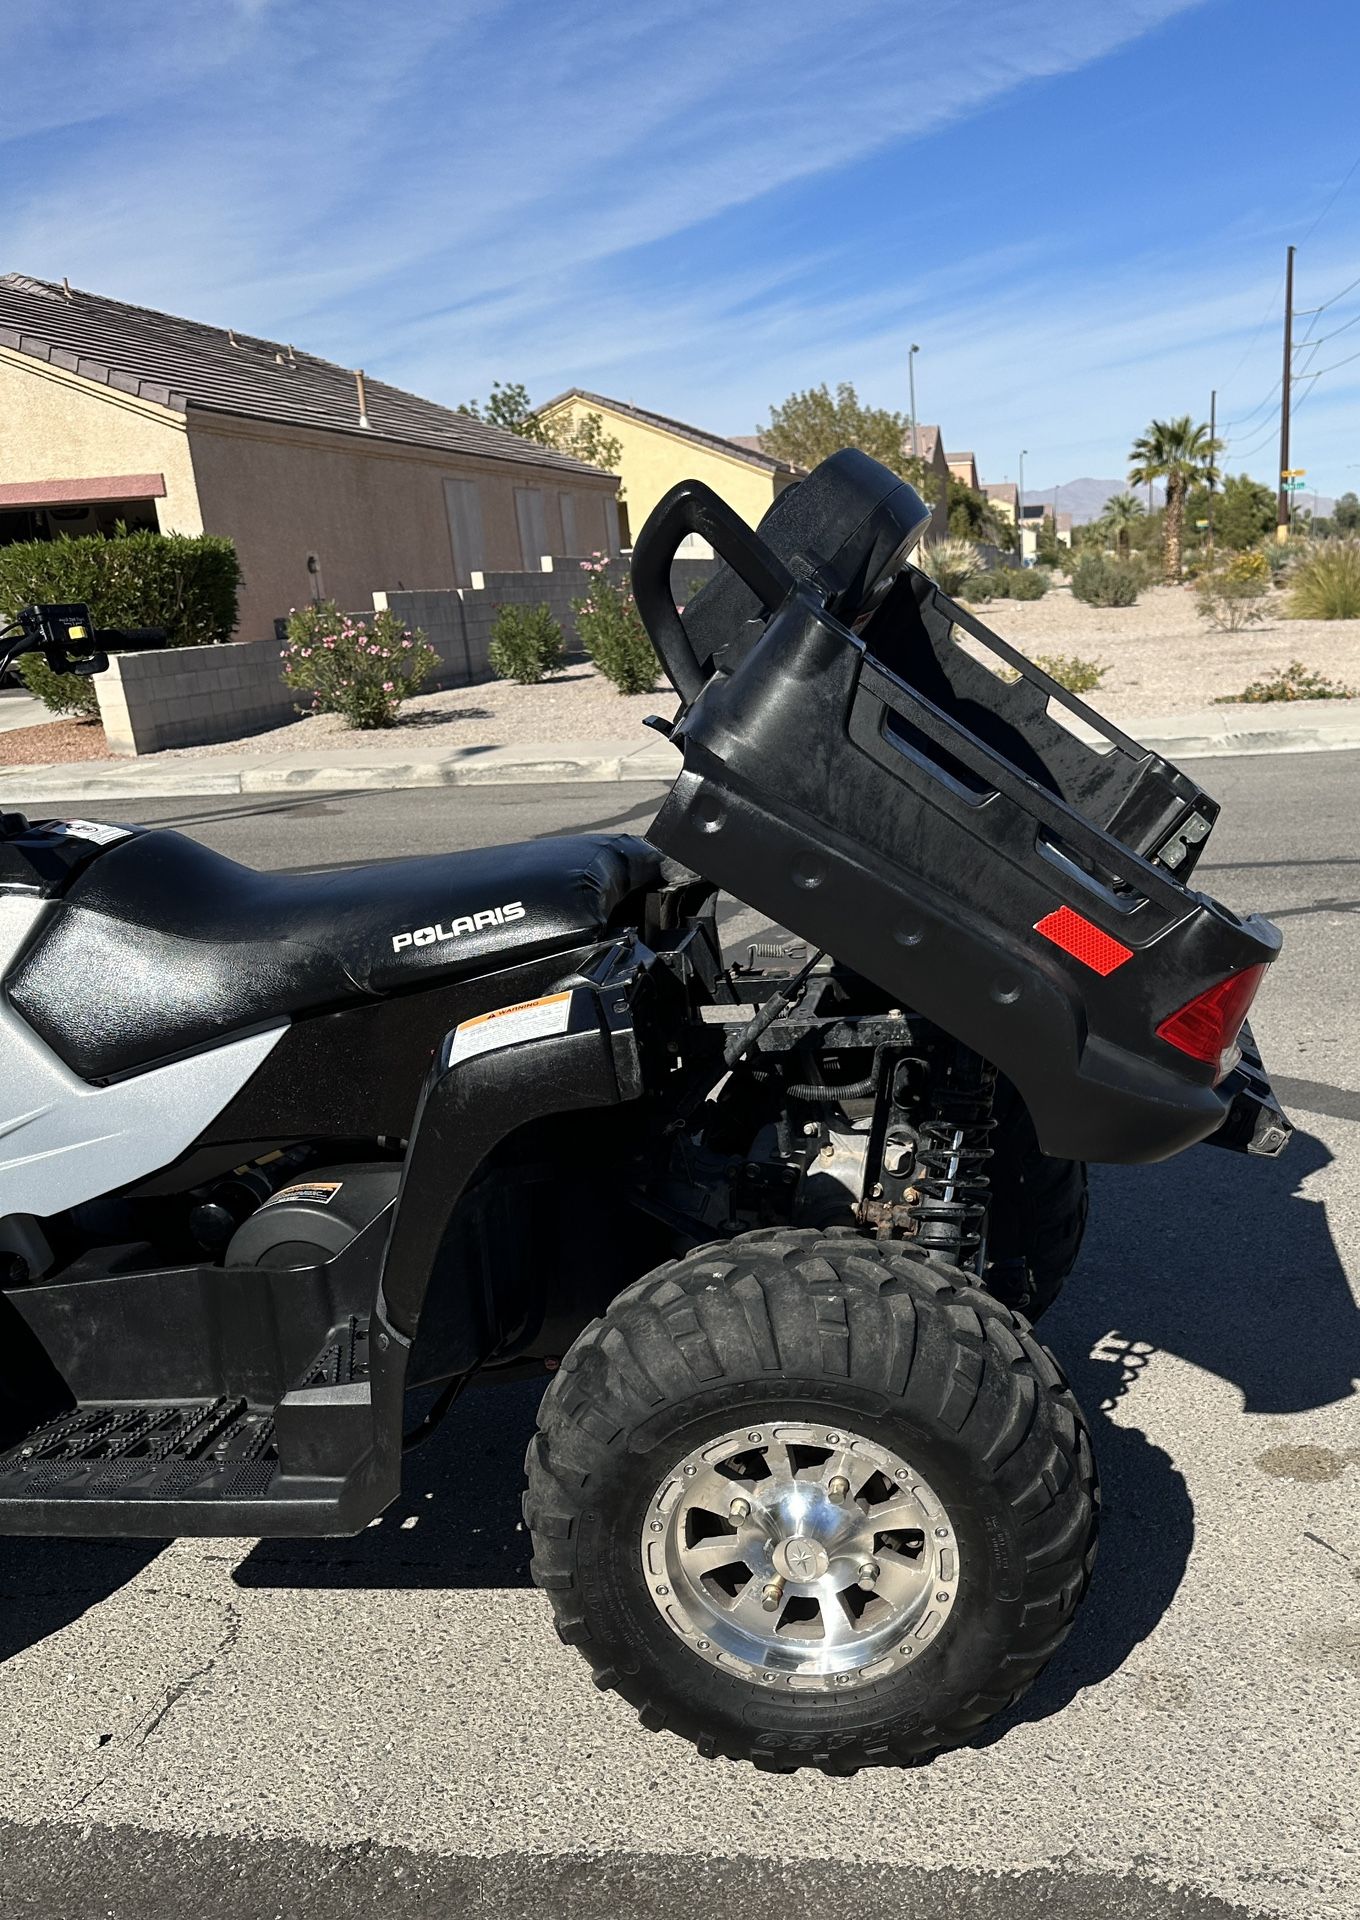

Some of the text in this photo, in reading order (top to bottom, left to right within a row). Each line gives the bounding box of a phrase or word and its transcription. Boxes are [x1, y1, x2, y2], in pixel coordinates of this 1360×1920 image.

[392, 901, 526, 953] POLARIS
[499, 1001, 540, 1016] WARNING
[669, 1380, 838, 1421] CARLISLE
